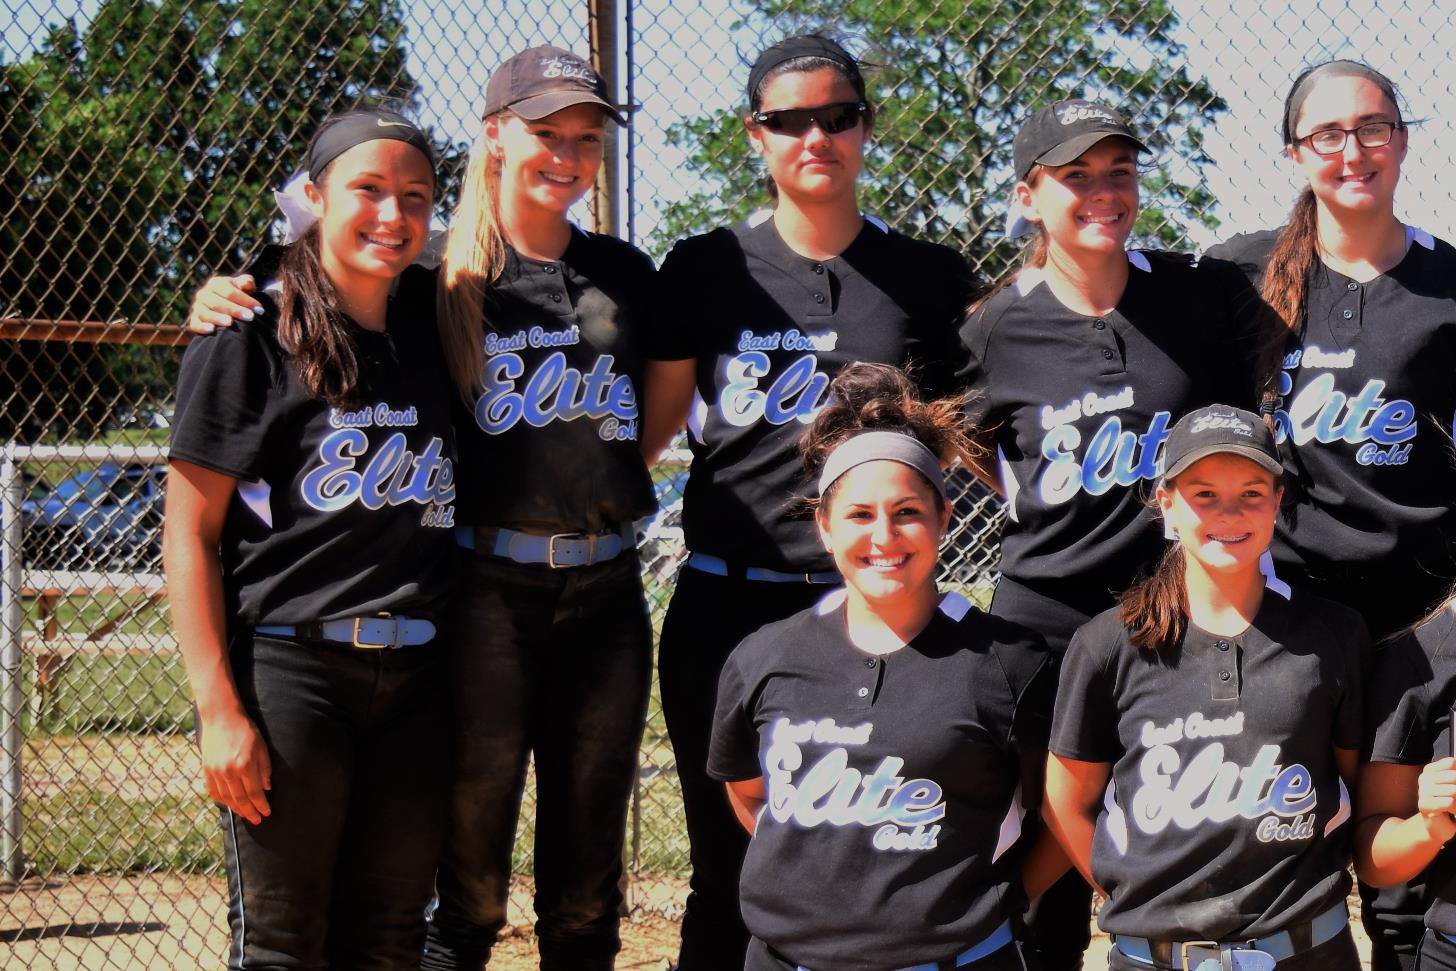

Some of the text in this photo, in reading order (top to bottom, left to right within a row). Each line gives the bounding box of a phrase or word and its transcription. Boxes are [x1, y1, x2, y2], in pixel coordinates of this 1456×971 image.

[485, 324, 581, 356] East Coast
[738, 330, 780, 351] East
[475, 351, 638, 435] Elite
[330, 402, 418, 428] East Coast
[301, 428, 456, 511] Elite
[1040, 411, 1173, 505] Elit
[1356, 442, 1413, 466] Gold
[766, 742, 946, 827] Elite
[1133, 742, 1317, 834] Elite
[873, 824, 941, 850] Gold
[1256, 814, 1316, 843] Gold
